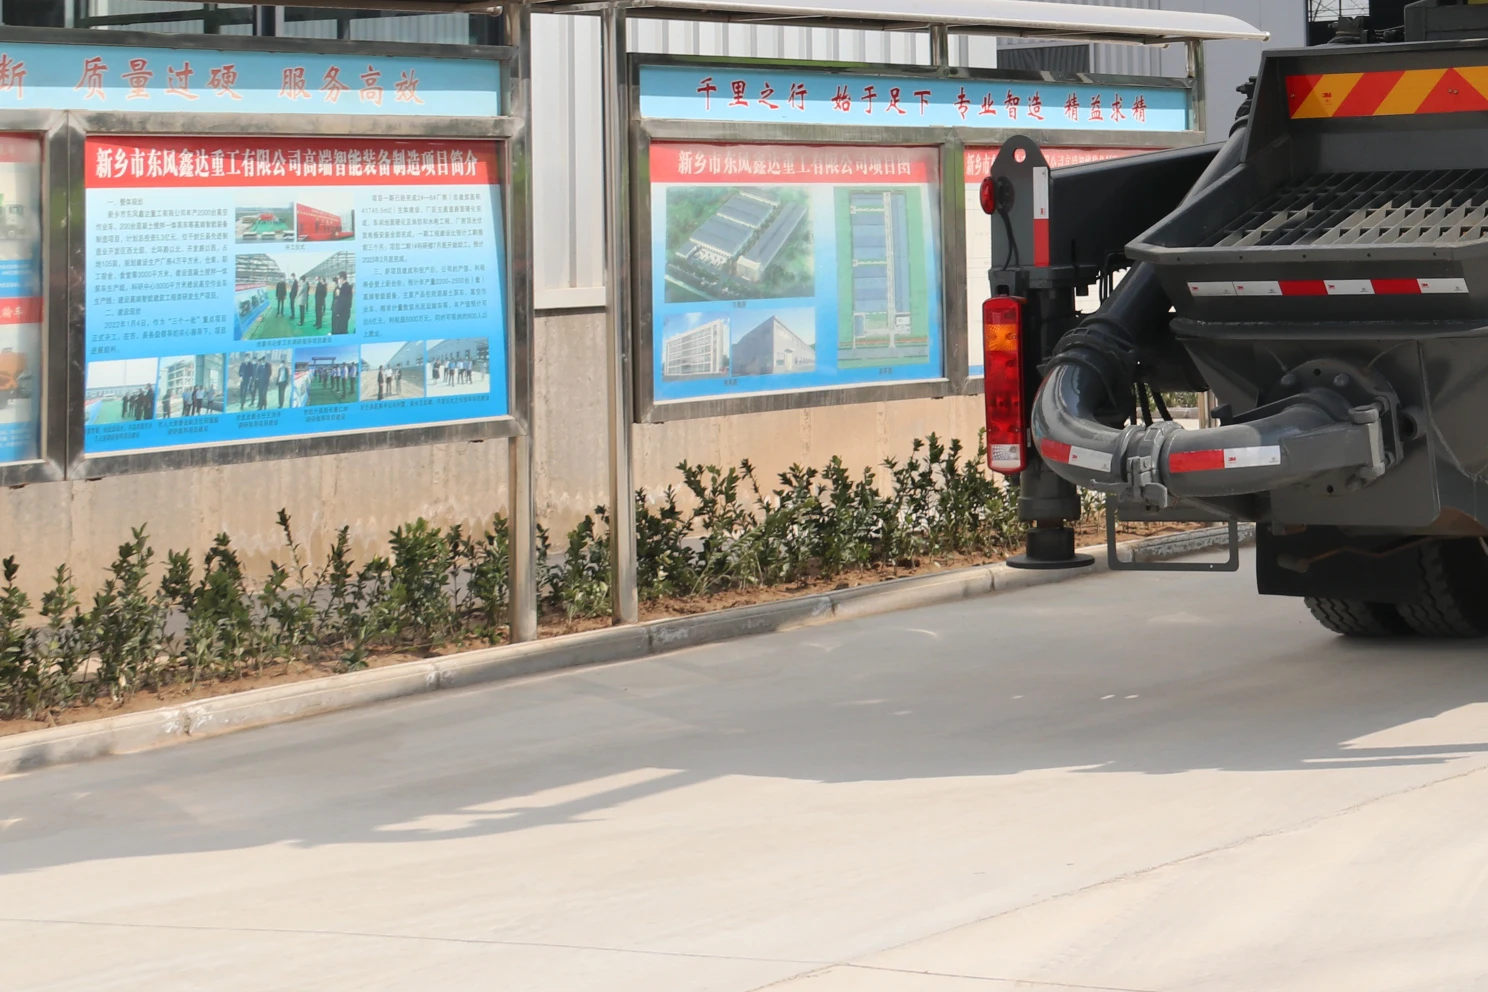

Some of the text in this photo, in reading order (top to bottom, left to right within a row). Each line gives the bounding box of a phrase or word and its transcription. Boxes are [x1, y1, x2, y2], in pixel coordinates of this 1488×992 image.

[74, 56, 244, 103] 质量过硬
[279, 65, 426, 105] 服务高效
[697, 77, 1148, 123] 千里之行 始于足下 专业智造 精益求精
